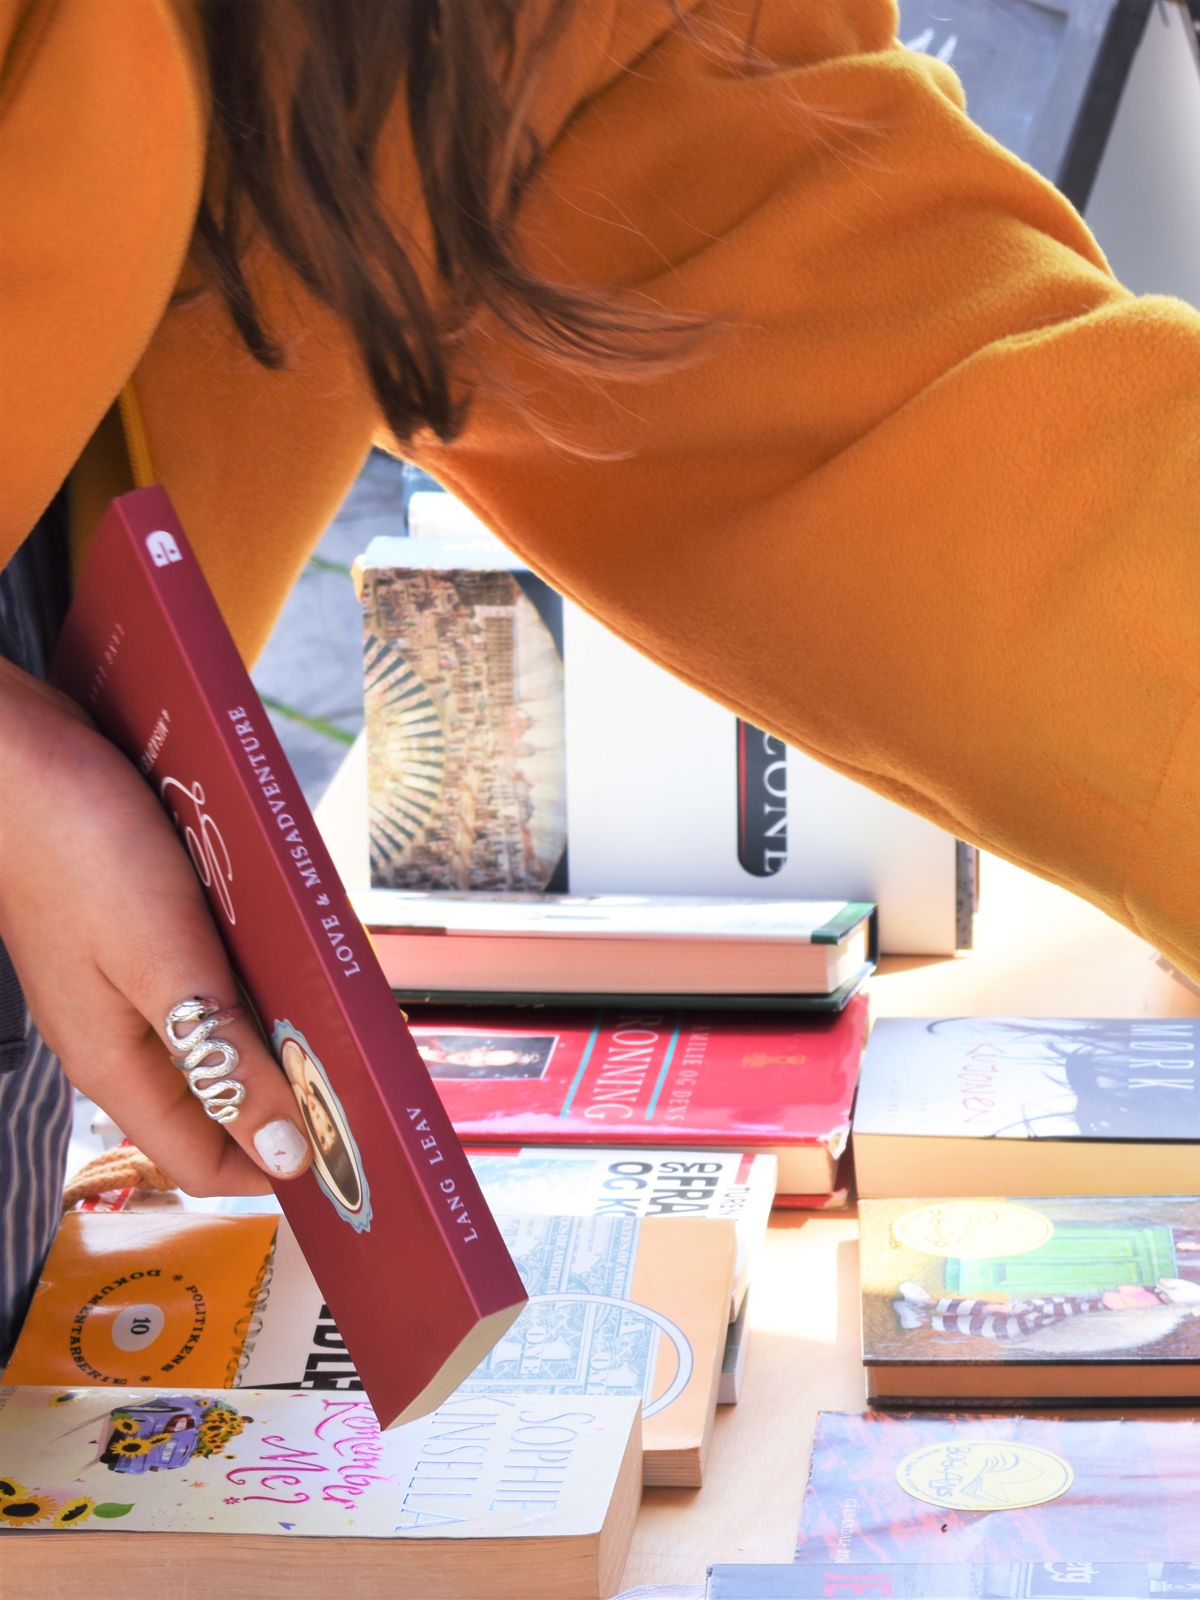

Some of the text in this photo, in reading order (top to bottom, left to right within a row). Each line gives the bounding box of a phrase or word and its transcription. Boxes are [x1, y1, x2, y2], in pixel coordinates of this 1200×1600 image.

[227, 705, 322, 889] MISADVENTURE
[320, 913, 362, 978] LOVE
[406, 1107, 480, 1244] LANG LEAV
[602, 1161, 655, 1191] OG
[659, 1161, 724, 1174] SYD
[129, 1315, 151, 1336] 10
[160, 1283, 208, 1375] POLITIKENS
[394, 1395, 520, 1532] KINSELLA
[488, 1410, 597, 1512] SOPHIE
